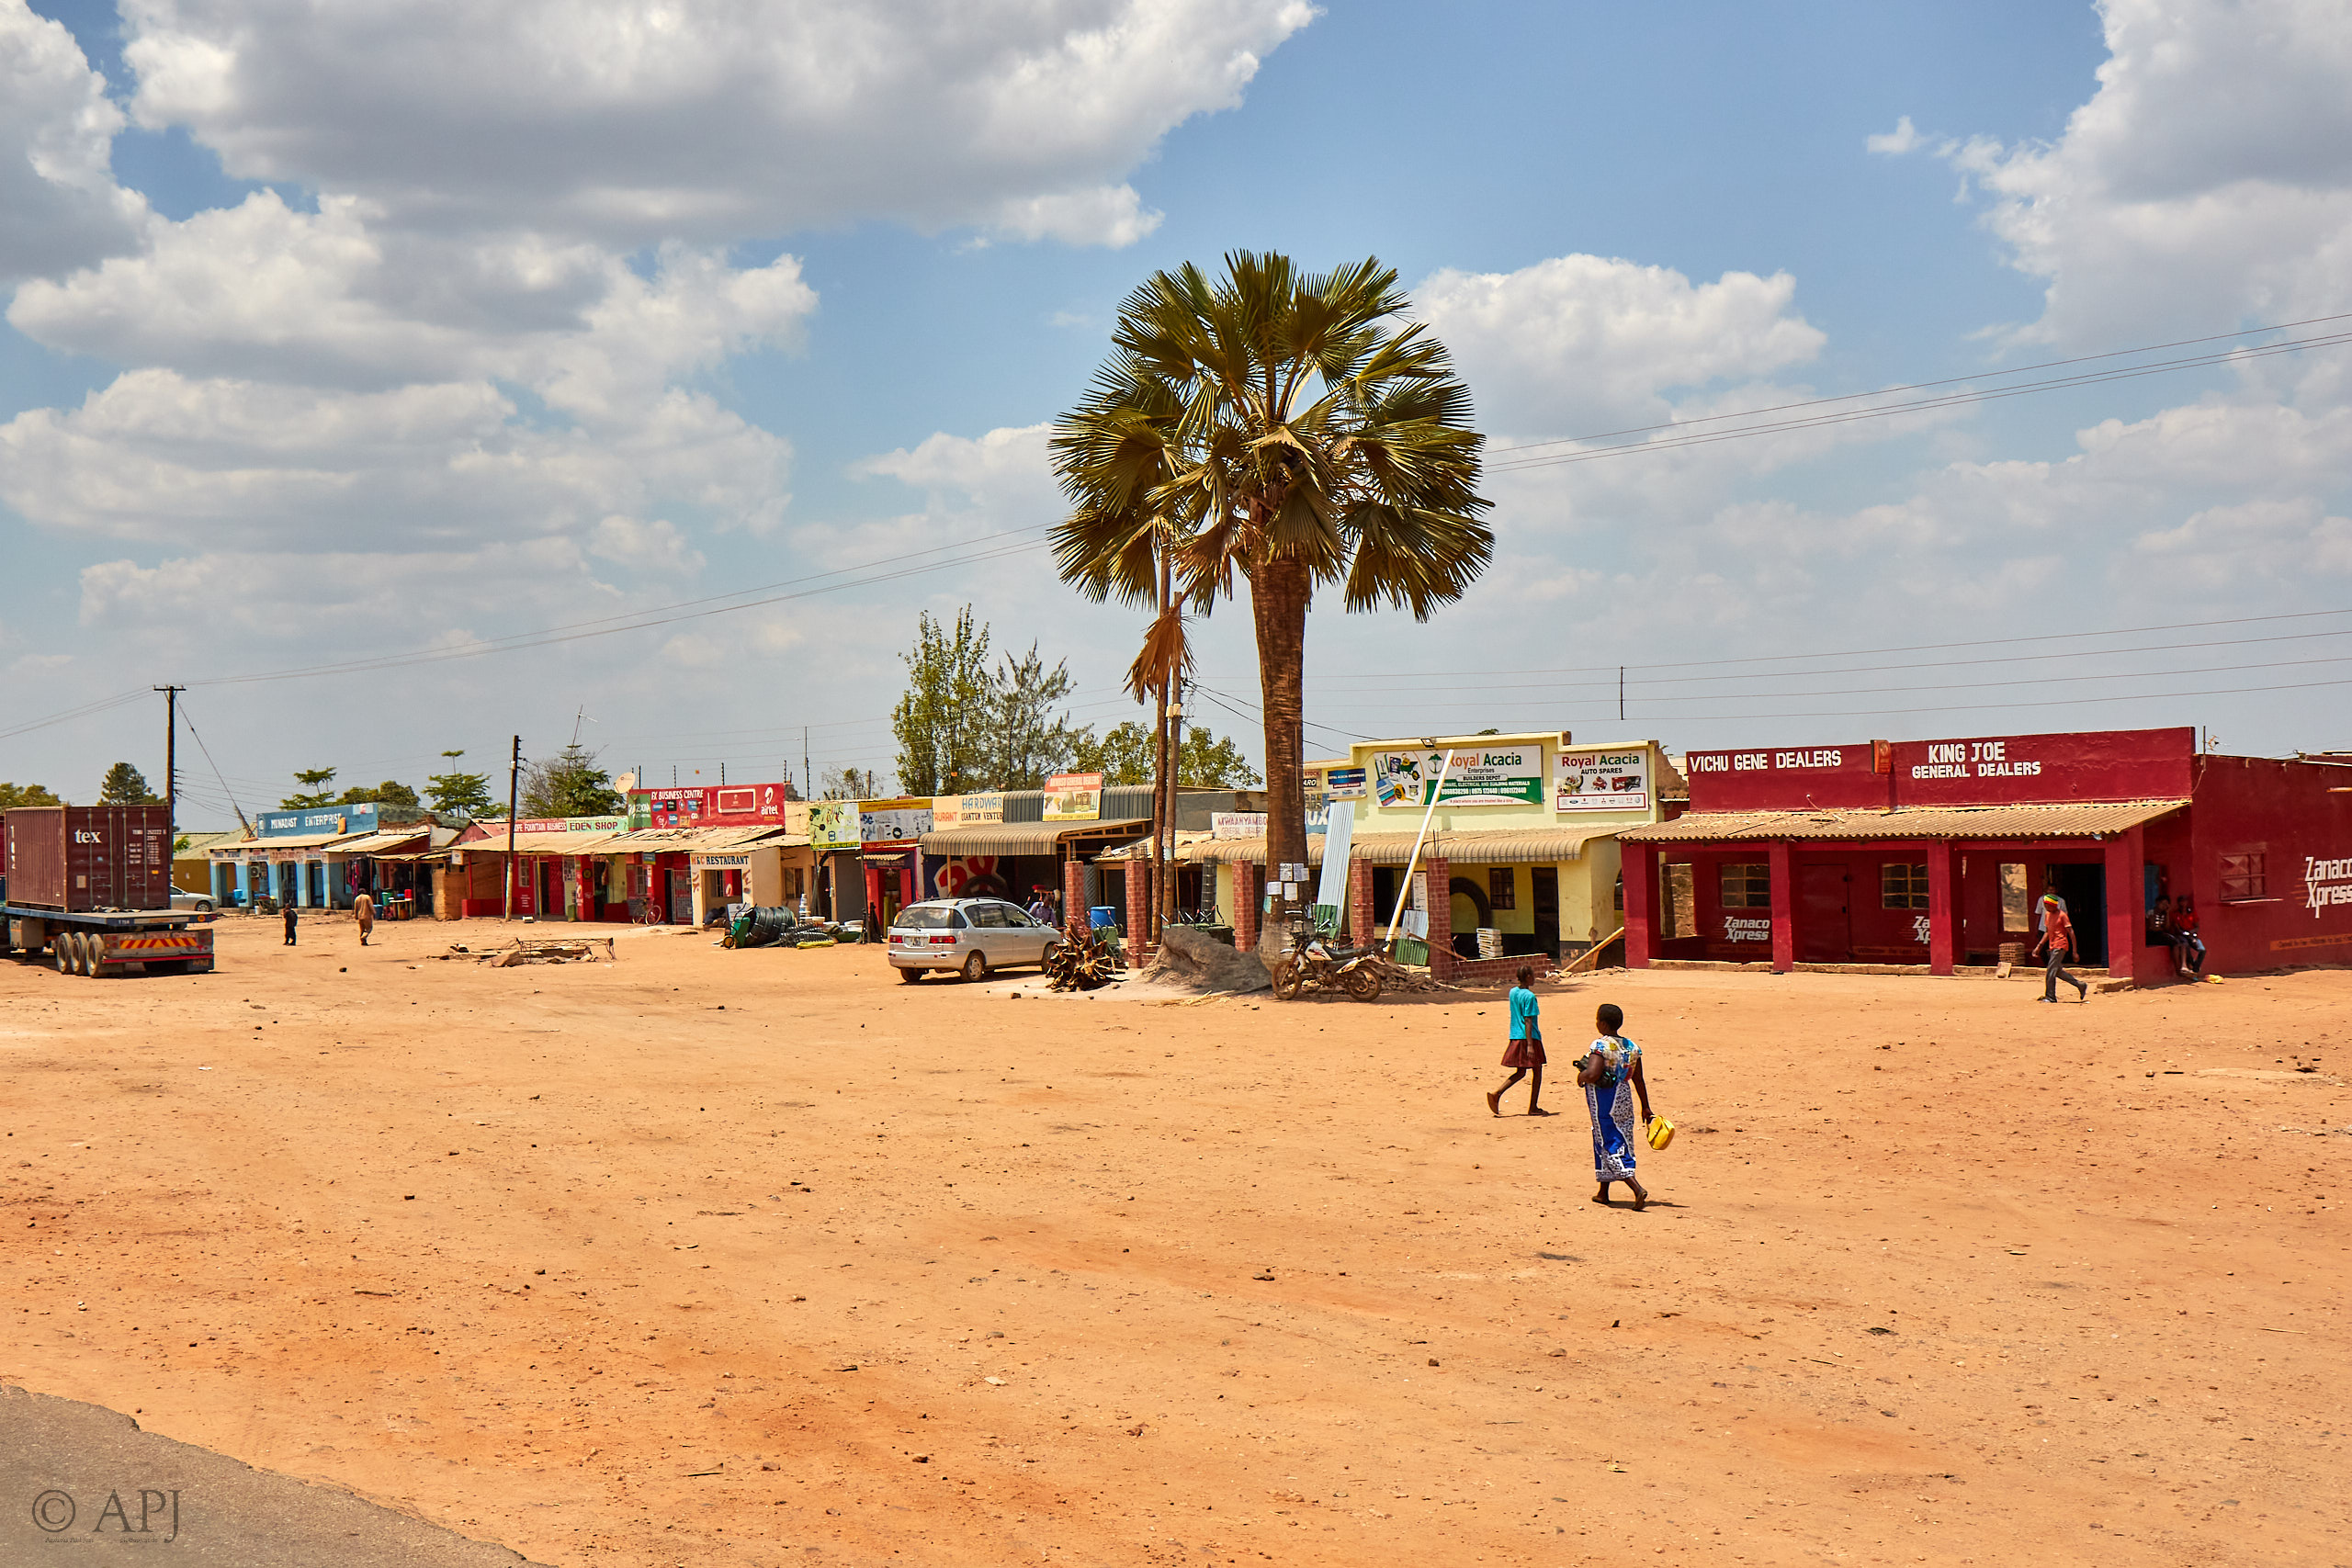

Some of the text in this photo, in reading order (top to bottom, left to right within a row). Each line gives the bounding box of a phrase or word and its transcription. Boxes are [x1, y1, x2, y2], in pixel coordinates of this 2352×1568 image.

[1483, 752, 1521, 766] Acacia
[1928, 741, 2006, 763] KING JOE
[1562, 753, 1640, 769] Royal Acacia
[1690, 750, 1842, 773] VICHU GENE DEALERS
[1911, 761, 2041, 779] GENERAL DEALERS
[658, 790, 684, 800] BUSINESS
[684, 789, 704, 799] CENTRE
[761, 805, 778, 816] airtel
[547, 822, 567, 831] BUSINESS
[570, 821, 618, 831] EDEN SHOP
[74, 829, 102, 844] tex
[706, 855, 750, 865] RESTAURANT
[1724, 916, 1770, 930] Zanaco
[1724, 928, 1770, 943] Xpress
